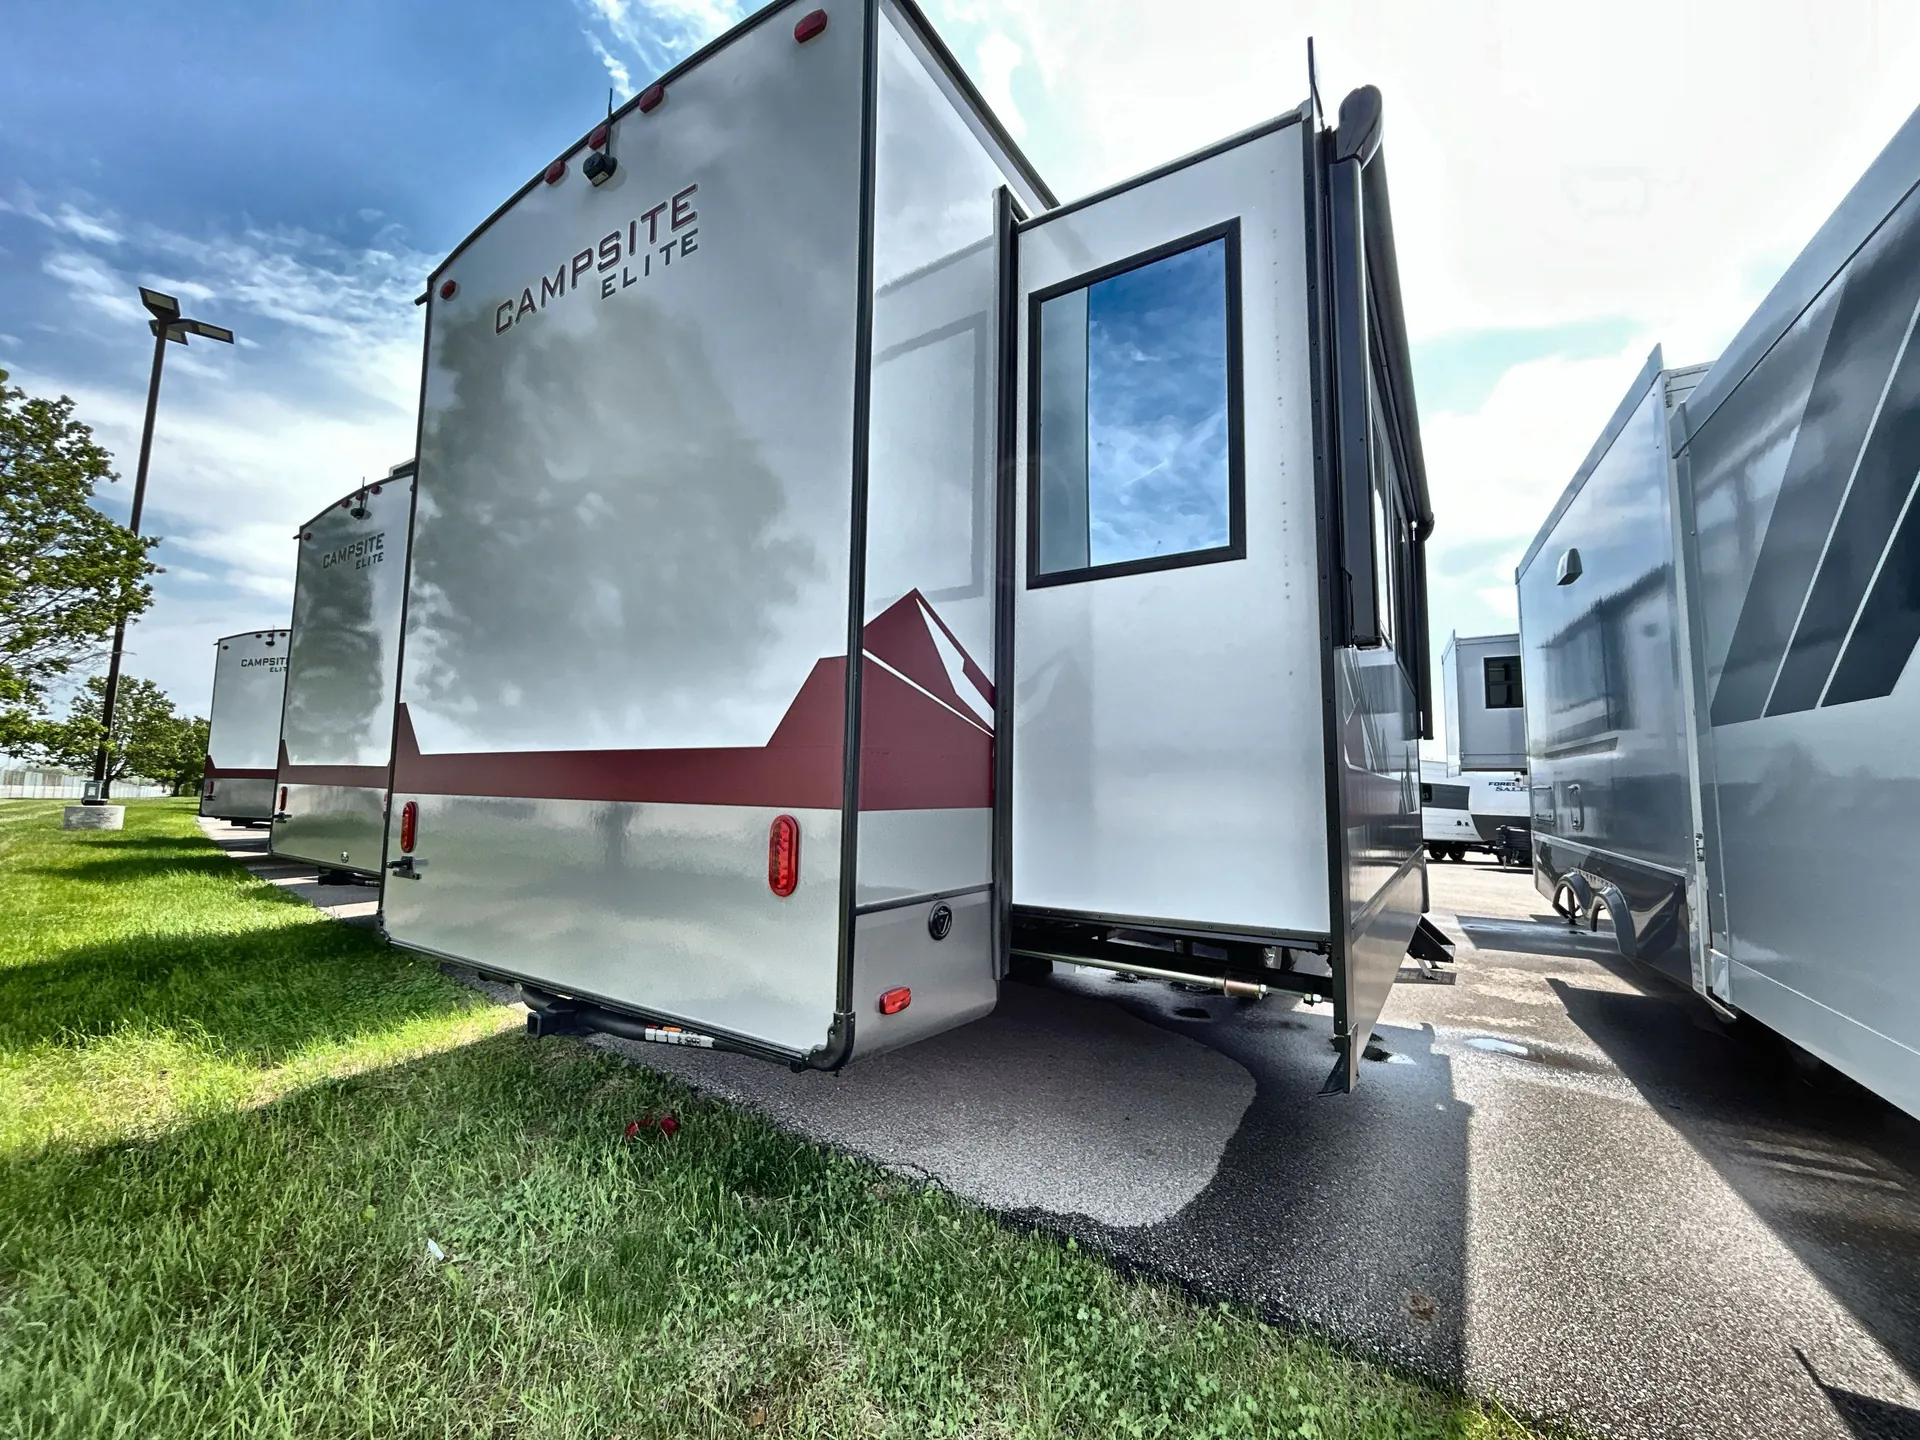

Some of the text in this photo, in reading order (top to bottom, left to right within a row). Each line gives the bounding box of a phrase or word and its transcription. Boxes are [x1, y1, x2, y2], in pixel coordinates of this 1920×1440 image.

[495, 183, 698, 335] CAMPSITE
[601, 228, 698, 300] ELITE
[322, 532, 385, 569] CAMPSITE
[355, 552, 384, 570] ELITE
[240, 657, 289, 668] CAMPSIT
